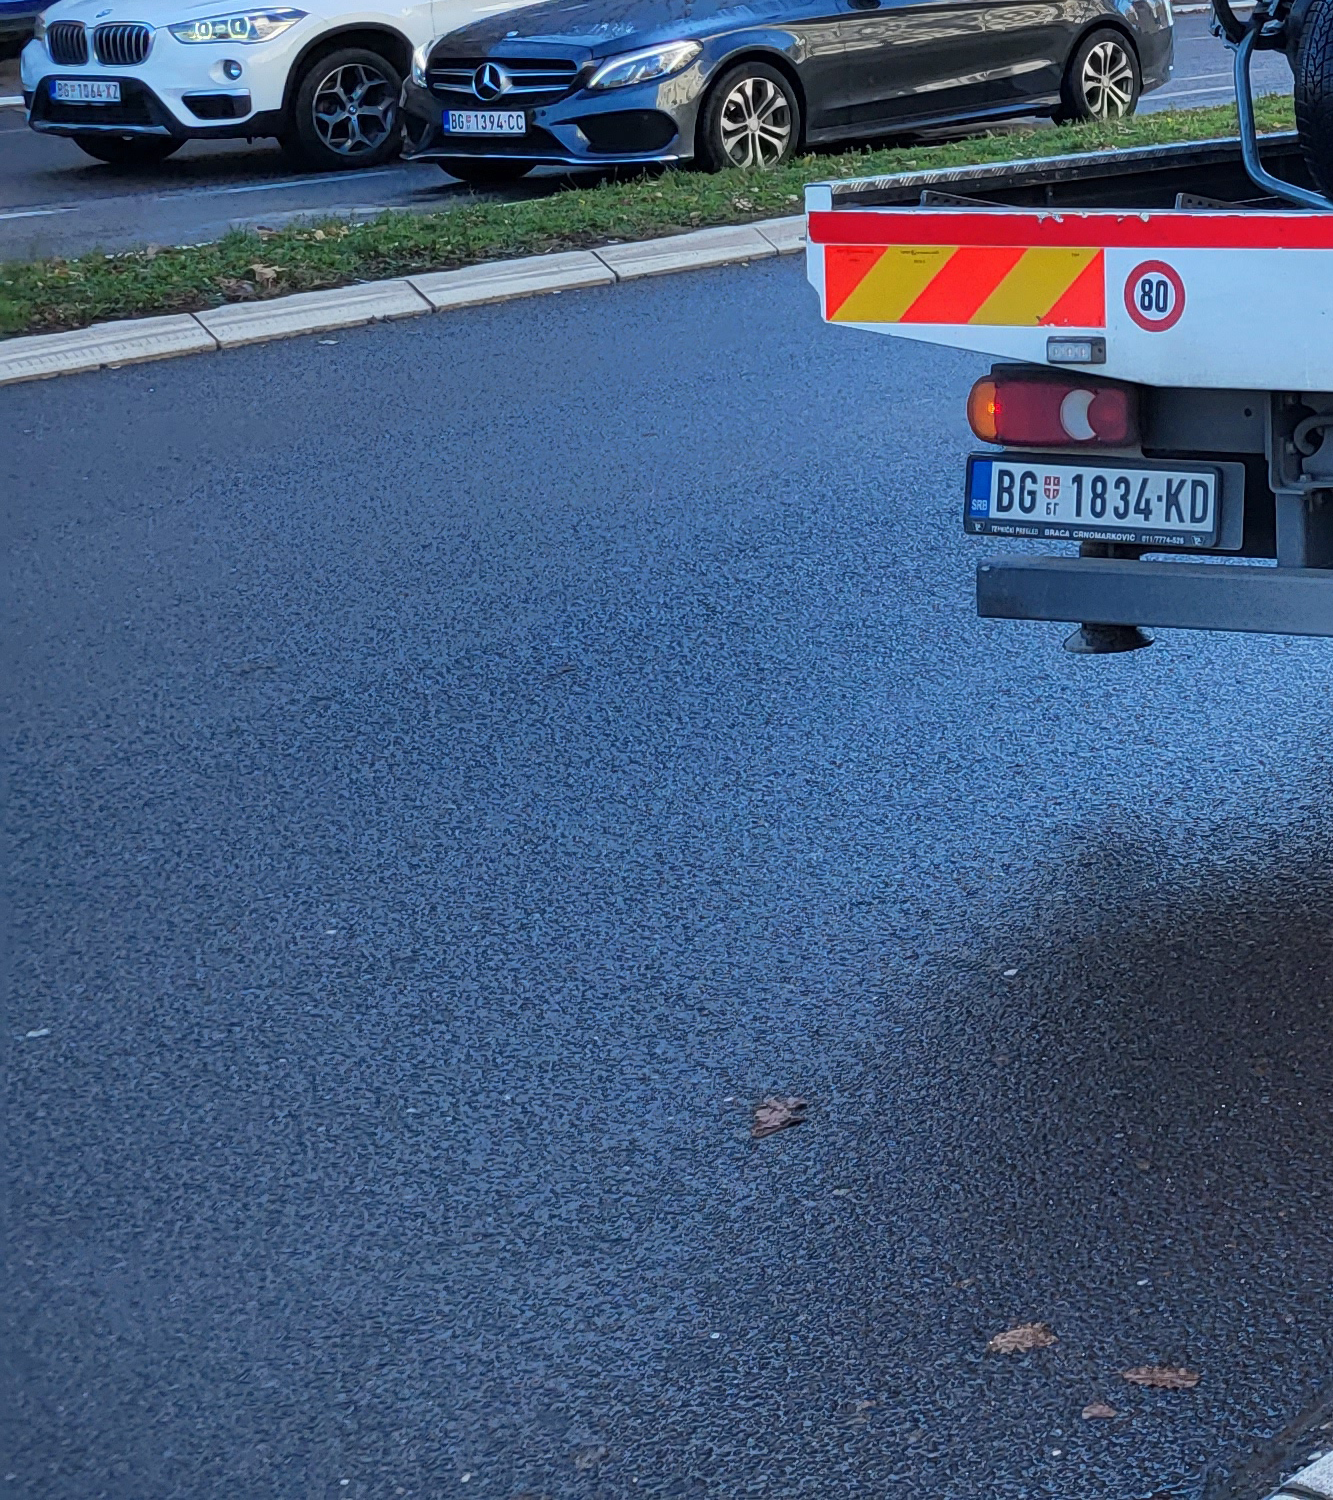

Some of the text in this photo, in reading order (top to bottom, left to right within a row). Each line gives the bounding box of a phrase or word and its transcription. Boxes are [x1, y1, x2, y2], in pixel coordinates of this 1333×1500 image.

[451, 113, 464, 130] BG
[1140, 278, 1169, 313] 80
[996, 469, 1039, 514] BG
[970, 499, 988, 512] SRB
[1045, 502, 1060, 516] БГ
